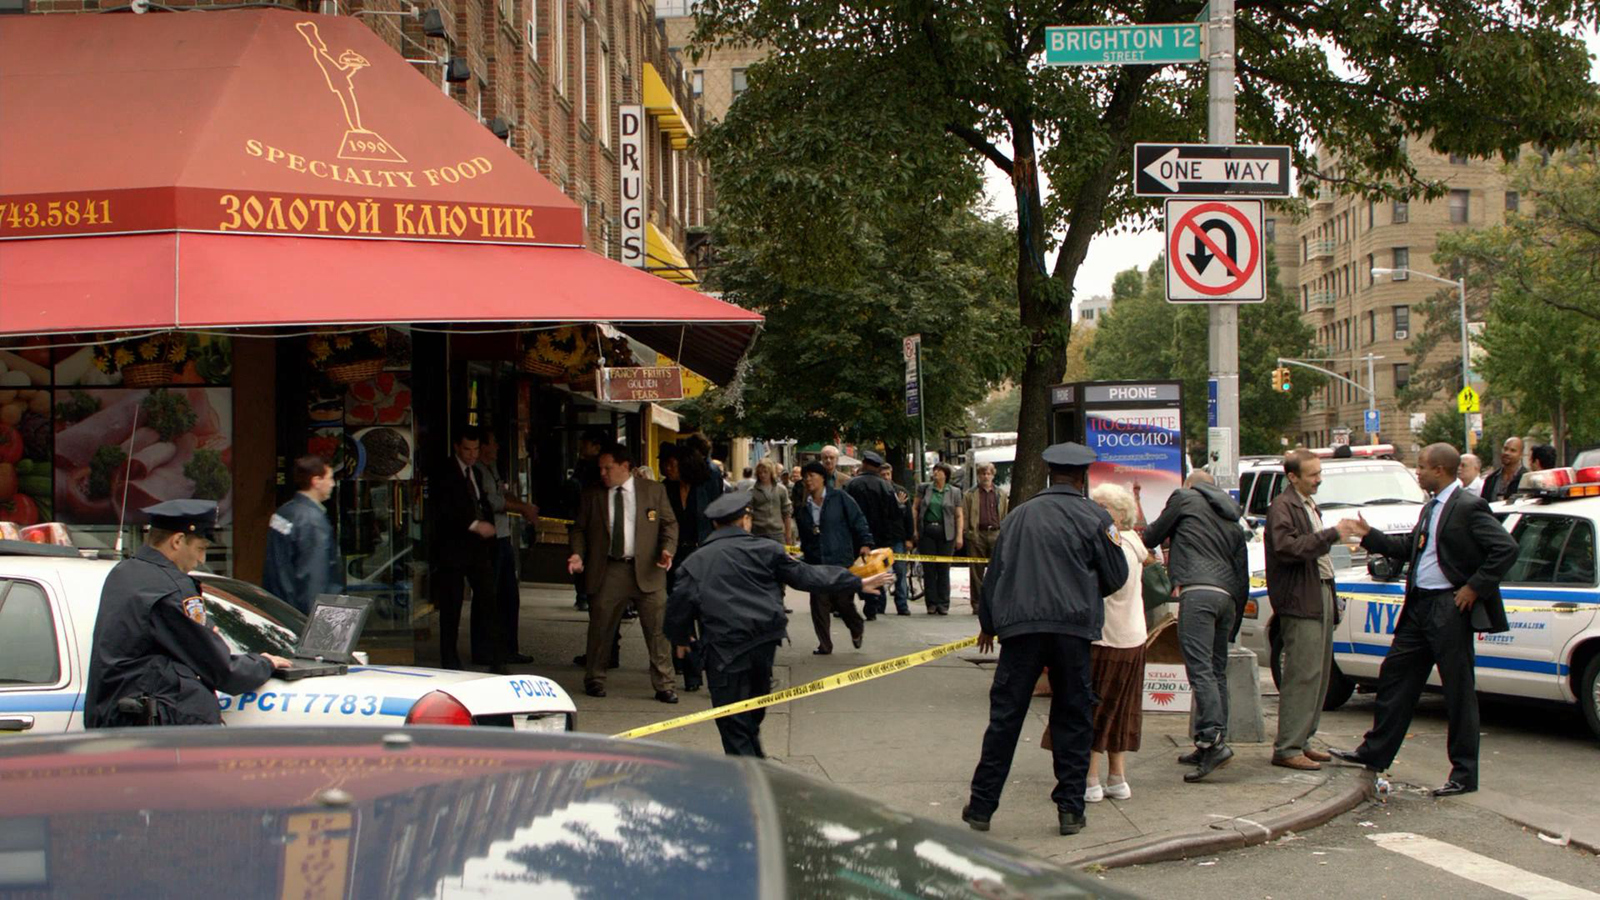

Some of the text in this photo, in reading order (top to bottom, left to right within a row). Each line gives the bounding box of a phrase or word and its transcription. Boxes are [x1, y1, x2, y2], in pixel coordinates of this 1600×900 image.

[1051, 28, 1196, 51] BRIGHTON 12
[1103, 50, 1146, 62] STREET
[349, 140, 388, 154] 1990
[245, 139, 494, 188] SPECIALTY FOOD
[1160, 161, 1270, 181] ONE WAY
[622, 113, 641, 261] DRUGS
[219, 194, 536, 239] ЗОЛОТОЙ КЛЮЧИК
[610, 369, 672, 379] FANCY FRUITS
[627, 379, 658, 389] GOLDEN
[1109, 387, 1157, 400] PHONE
[1090, 416, 1176, 431] ПОСЕТИТЕ
[1097, 432, 1174, 447] РОССИЮ!
[1148, 671, 1177, 679] APPLES
[509, 679, 557, 699] POLICE
[237, 692, 297, 712] PCT
[303, 693, 378, 716] 7783
